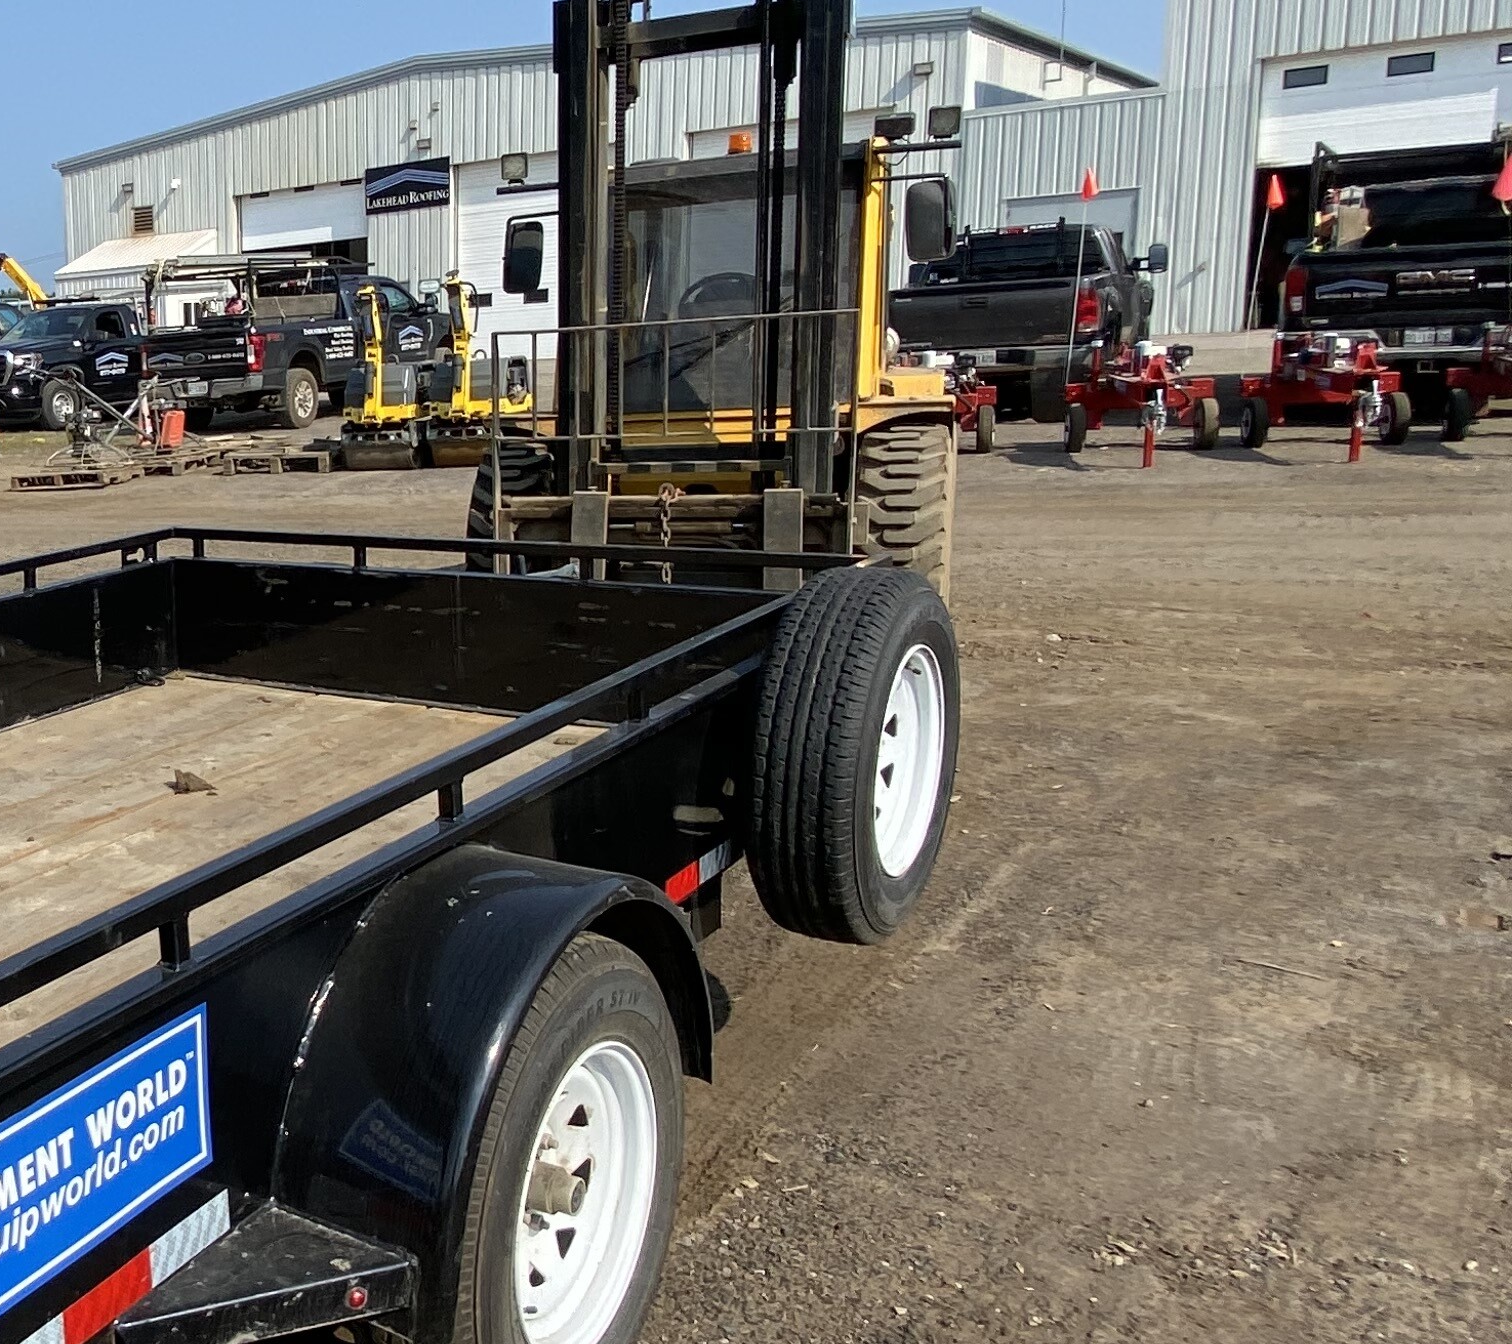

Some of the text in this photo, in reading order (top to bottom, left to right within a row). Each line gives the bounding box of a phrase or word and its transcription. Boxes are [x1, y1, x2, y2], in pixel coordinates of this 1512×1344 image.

[366, 188, 449, 210] LAKEHEAD ROOFING
[85, 1058, 188, 1149] WORLD
